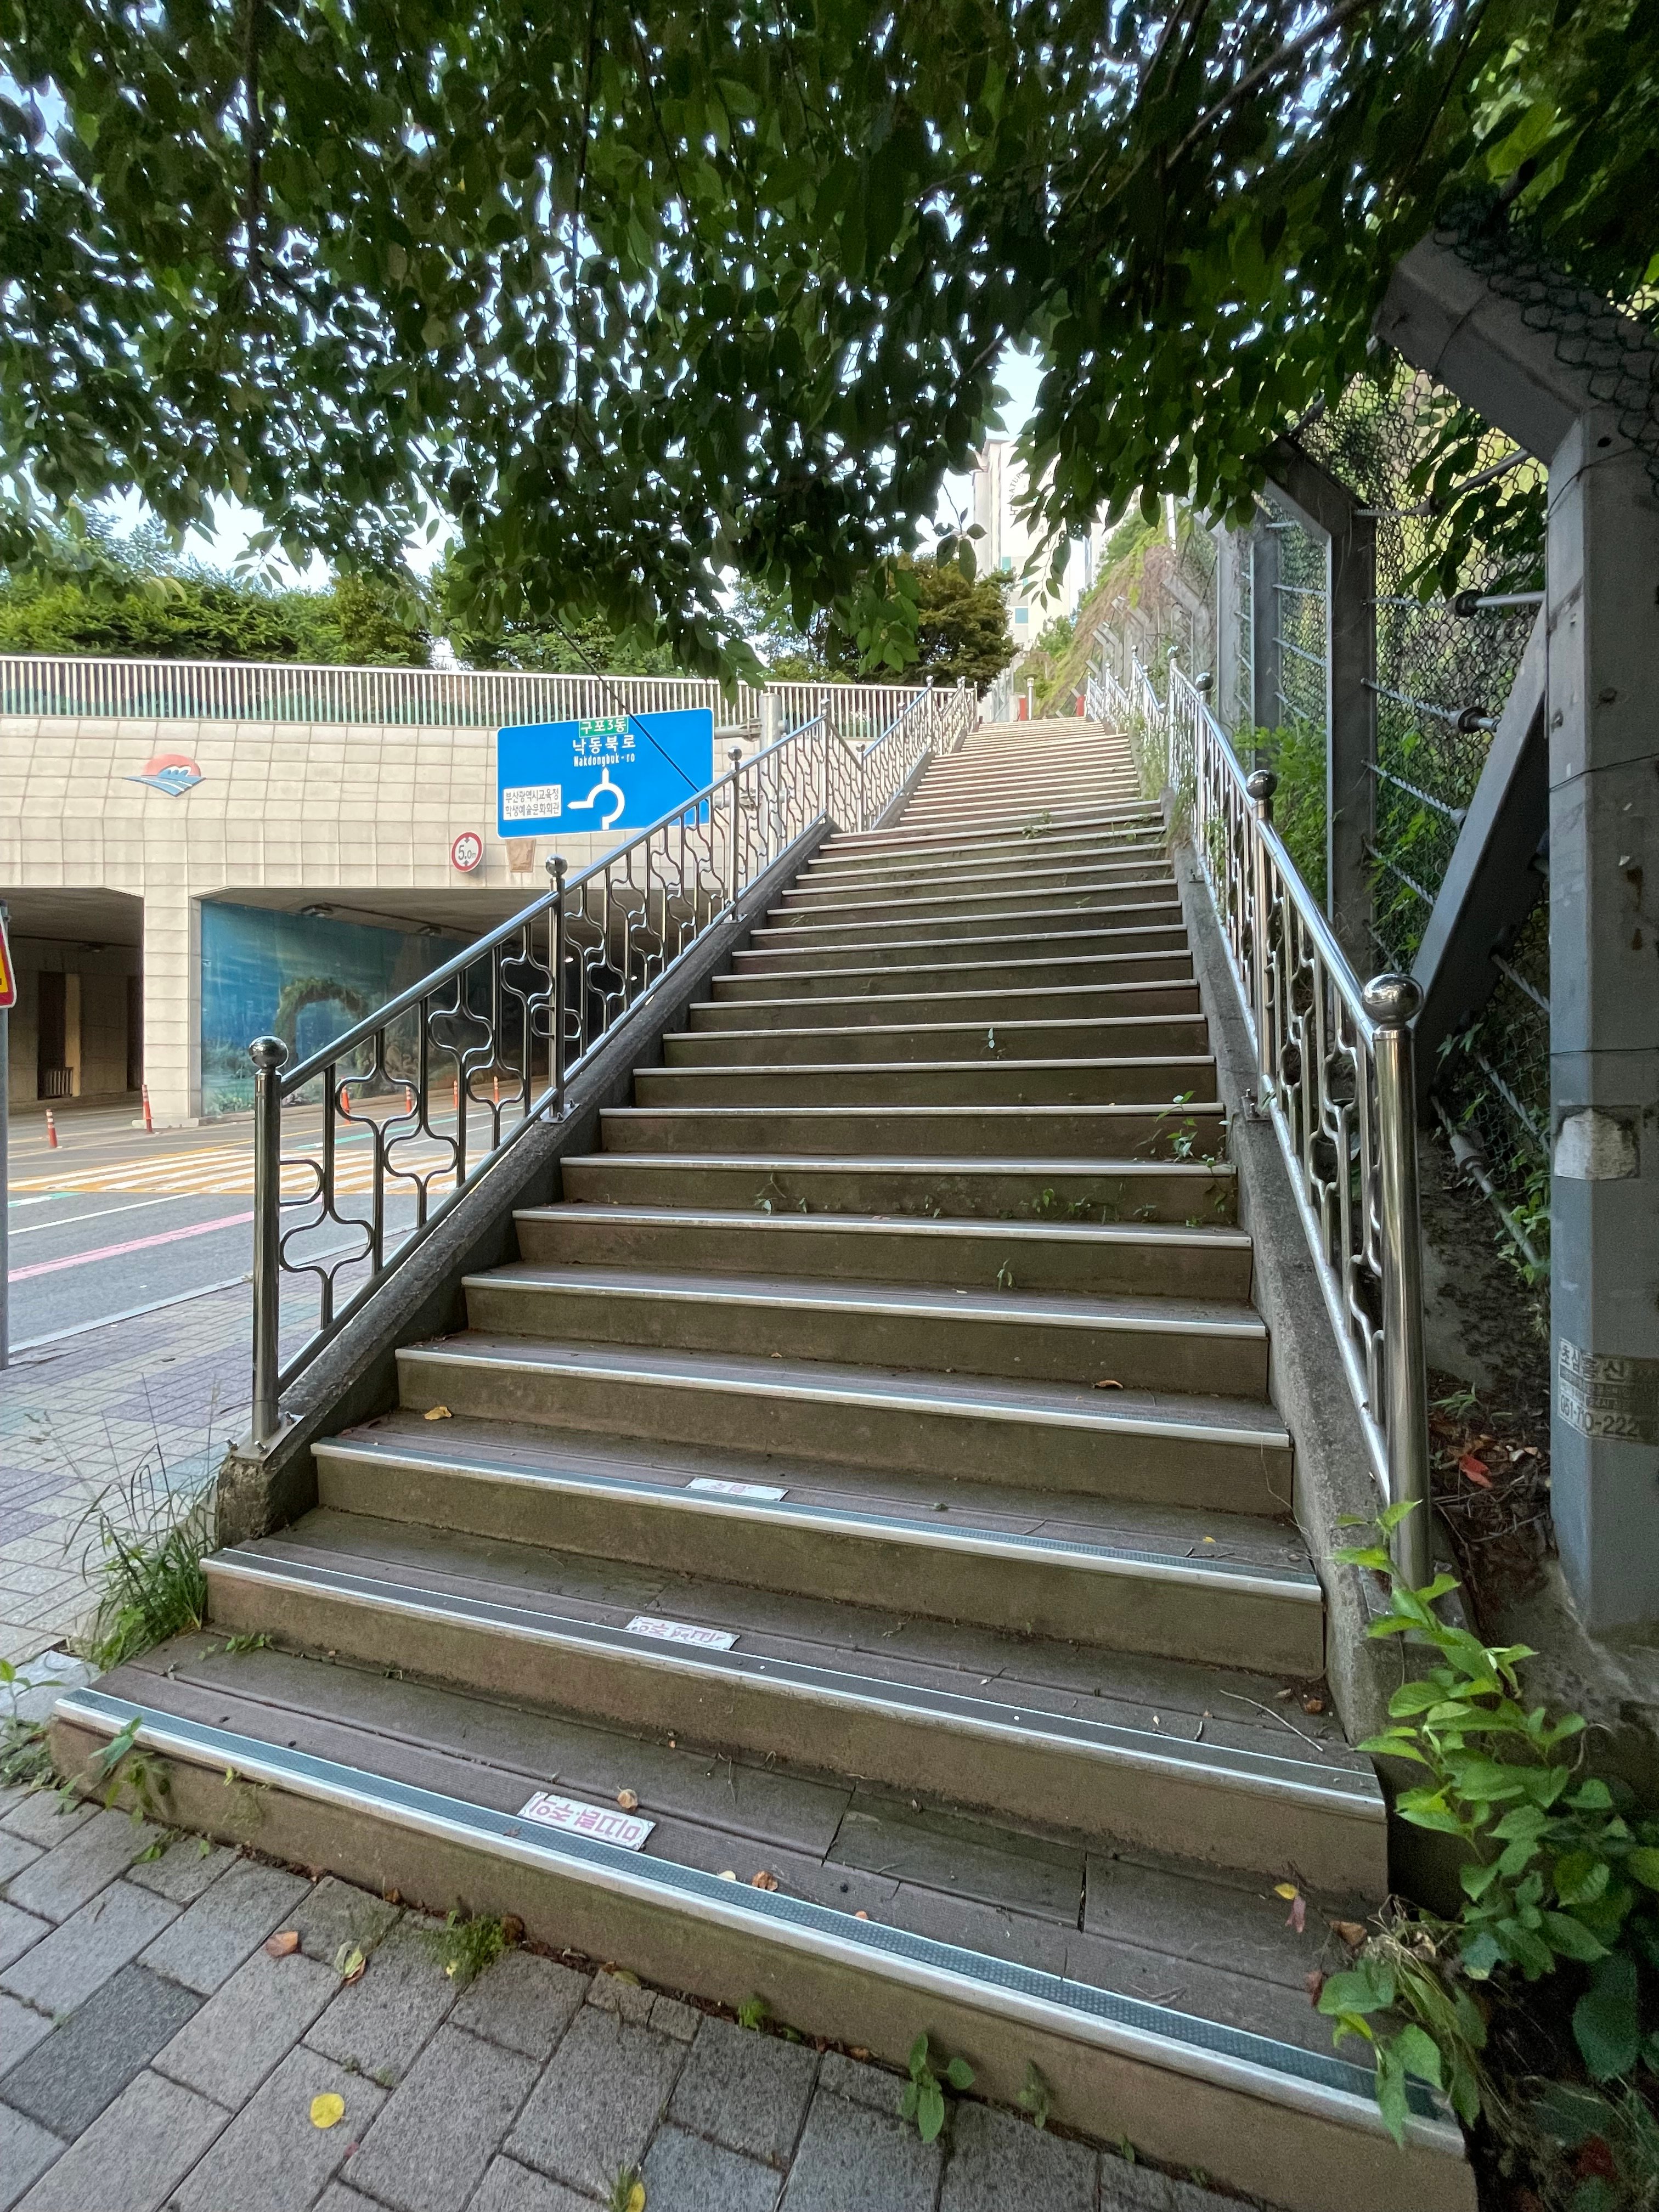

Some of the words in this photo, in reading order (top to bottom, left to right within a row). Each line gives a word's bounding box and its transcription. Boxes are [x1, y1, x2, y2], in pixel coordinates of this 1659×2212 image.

[580, 718, 626, 735] 구포3동
[573, 735, 636, 755] 낙동북로
[574, 753, 635, 767] Nakdongbuk-ro
[505, 788, 558, 804] 부산광역시교육청
[505, 802, 559, 817] 학생예술문화회관
[458, 845, 476, 861] 5.0m
[530, 1799, 574, 1822] 주의
[574, 1809, 641, 1841] 미끄럼
